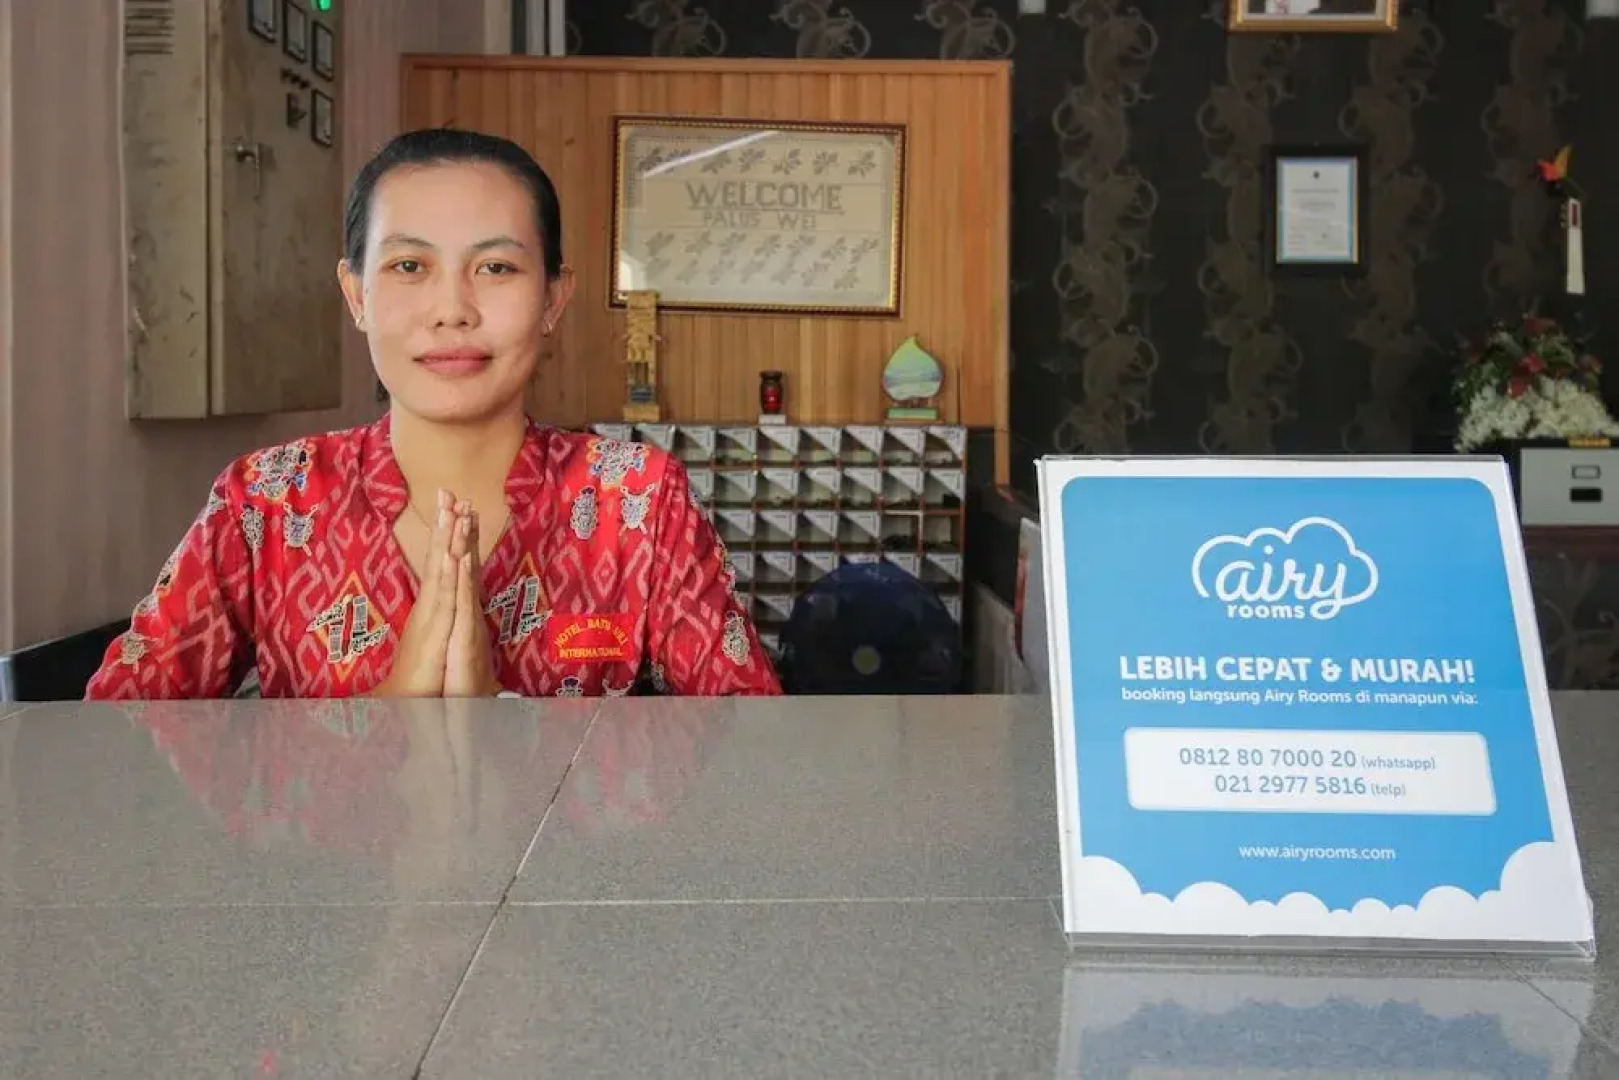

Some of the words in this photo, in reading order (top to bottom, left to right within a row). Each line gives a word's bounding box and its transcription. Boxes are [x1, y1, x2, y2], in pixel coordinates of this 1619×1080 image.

[685, 181, 843, 210] WELCOME
[1215, 545, 1348, 620] airy
[1227, 604, 1305, 619] rooms
[553, 622, 587, 648] HOTEL
[1119, 655, 1207, 681] LEBIH
[1216, 656, 1311, 681] CEPAT
[1321, 657, 1342, 683] &
[1351, 658, 1475, 683] MURAH!
[1121, 687, 1186, 705] booking
[1190, 688, 1260, 706] langsung
[1264, 688, 1293, 705] Airy
[1298, 689, 1351, 703] Rooms
[1355, 690, 1371, 704] di
[1375, 692, 1447, 707] manapun
[1452, 691, 1478, 705] via:
[1179, 748, 1230, 765] 0812
[1237, 749, 1263, 766] 80
[1269, 749, 1324, 767] 7000
[1330, 750, 1356, 767] 20
[1361, 756, 1436, 771] (whatsapp)
[1215, 775, 1252, 793] 021
[1259, 776, 1308, 794] 2977
[1315, 777, 1366, 794] 5816
[1371, 783, 1406, 798] (telp)
[1238, 844, 1397, 862] www.airyrooms.com
